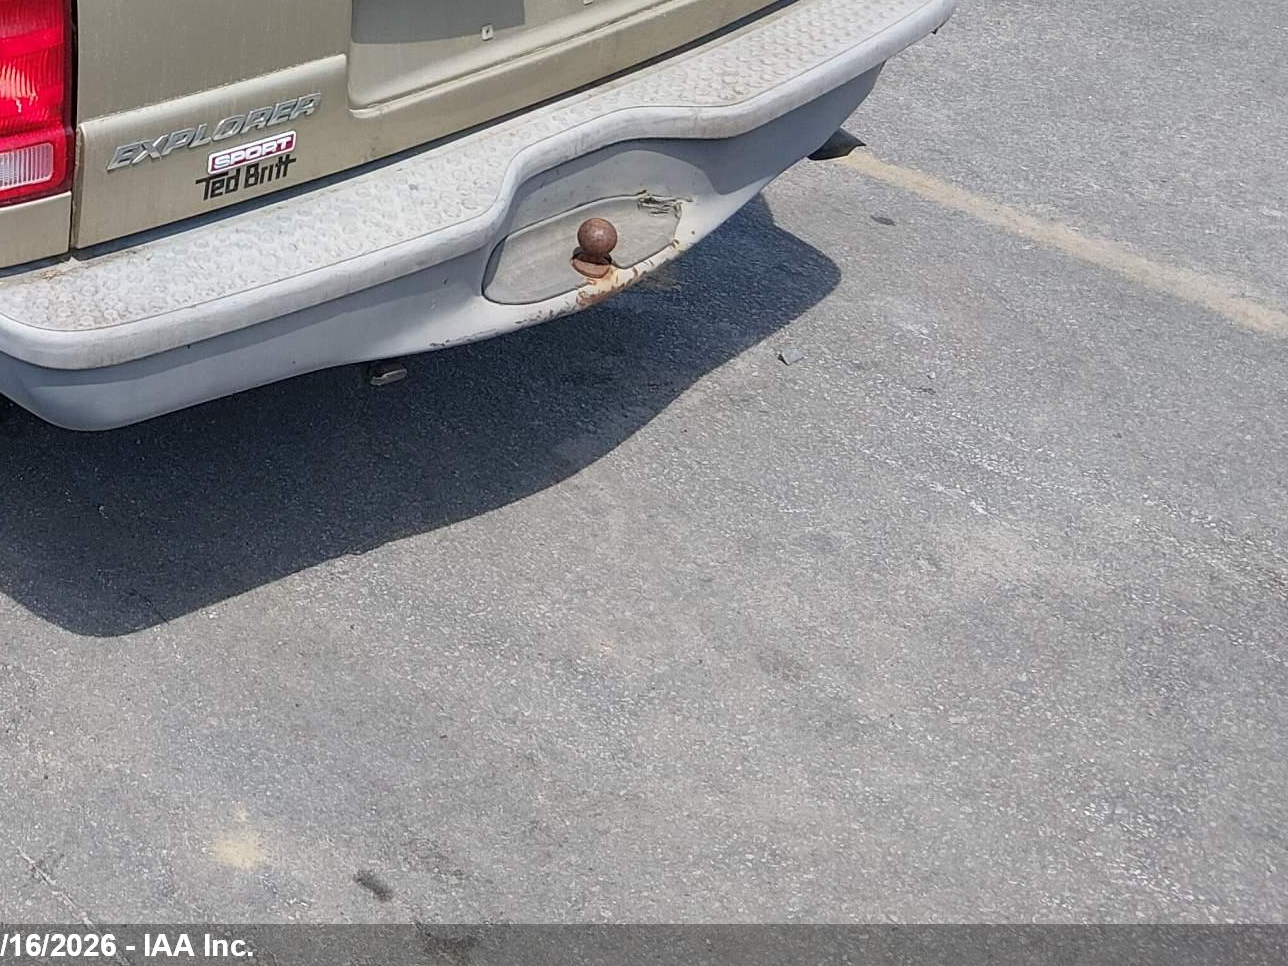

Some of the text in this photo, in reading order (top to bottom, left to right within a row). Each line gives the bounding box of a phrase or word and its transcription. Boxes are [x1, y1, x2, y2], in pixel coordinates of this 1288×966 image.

[105, 92, 321, 172] EXPLORER
[214, 136, 292, 169] SPORT
[195, 153, 297, 201] Ted Britt
